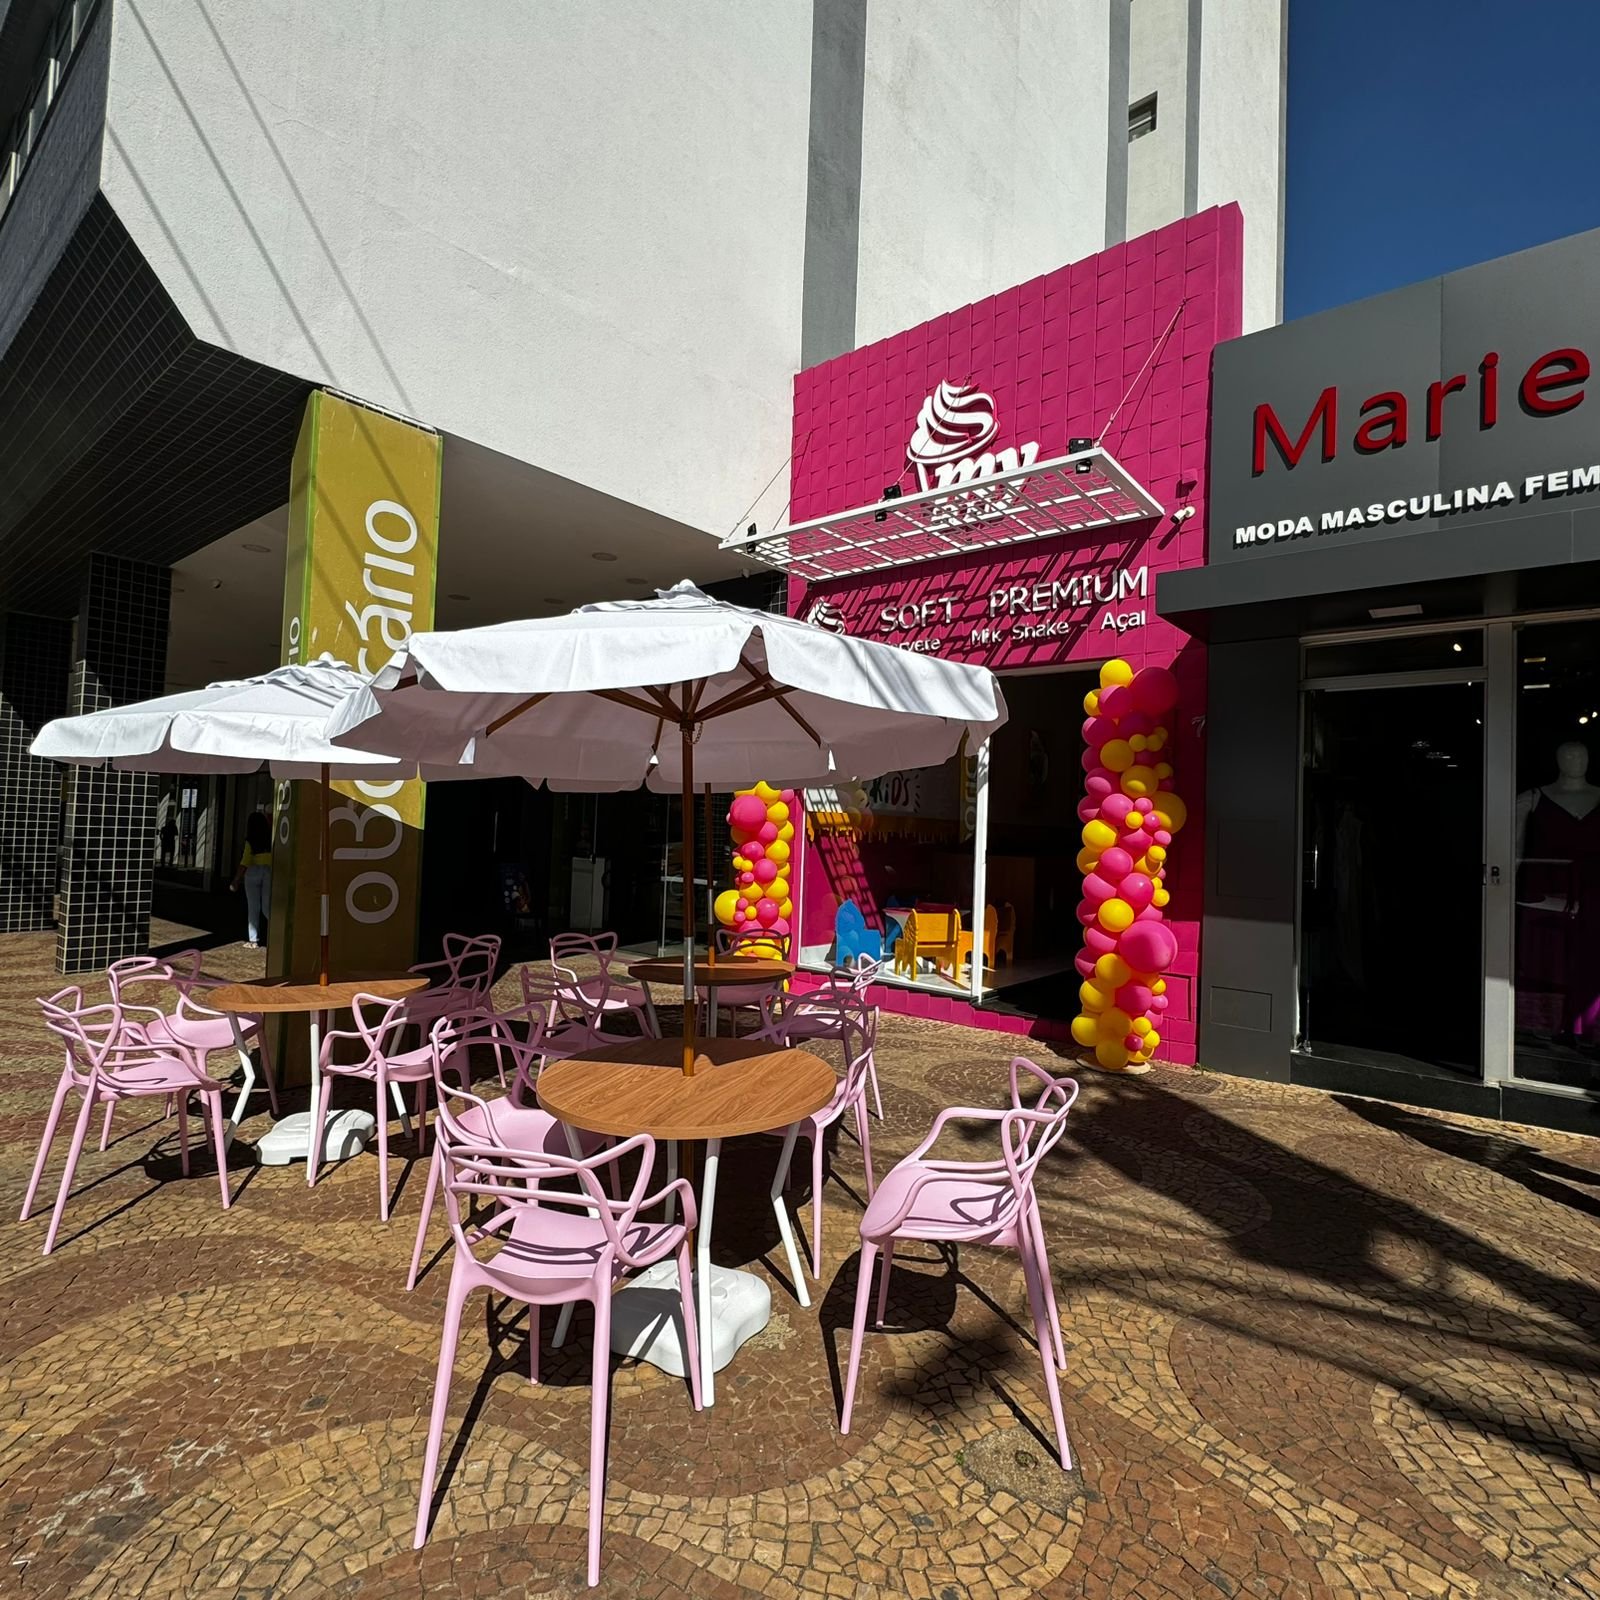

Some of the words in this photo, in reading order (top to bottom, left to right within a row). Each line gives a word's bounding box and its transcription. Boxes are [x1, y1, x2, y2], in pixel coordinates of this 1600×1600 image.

[1251, 348, 1591, 476] Marie
[1234, 516, 1314, 544] MODA
[1320, 481, 1515, 530] MASCULINA
[879, 596, 960, 632] SOFT
[989, 565, 1149, 618] PREMIUM
